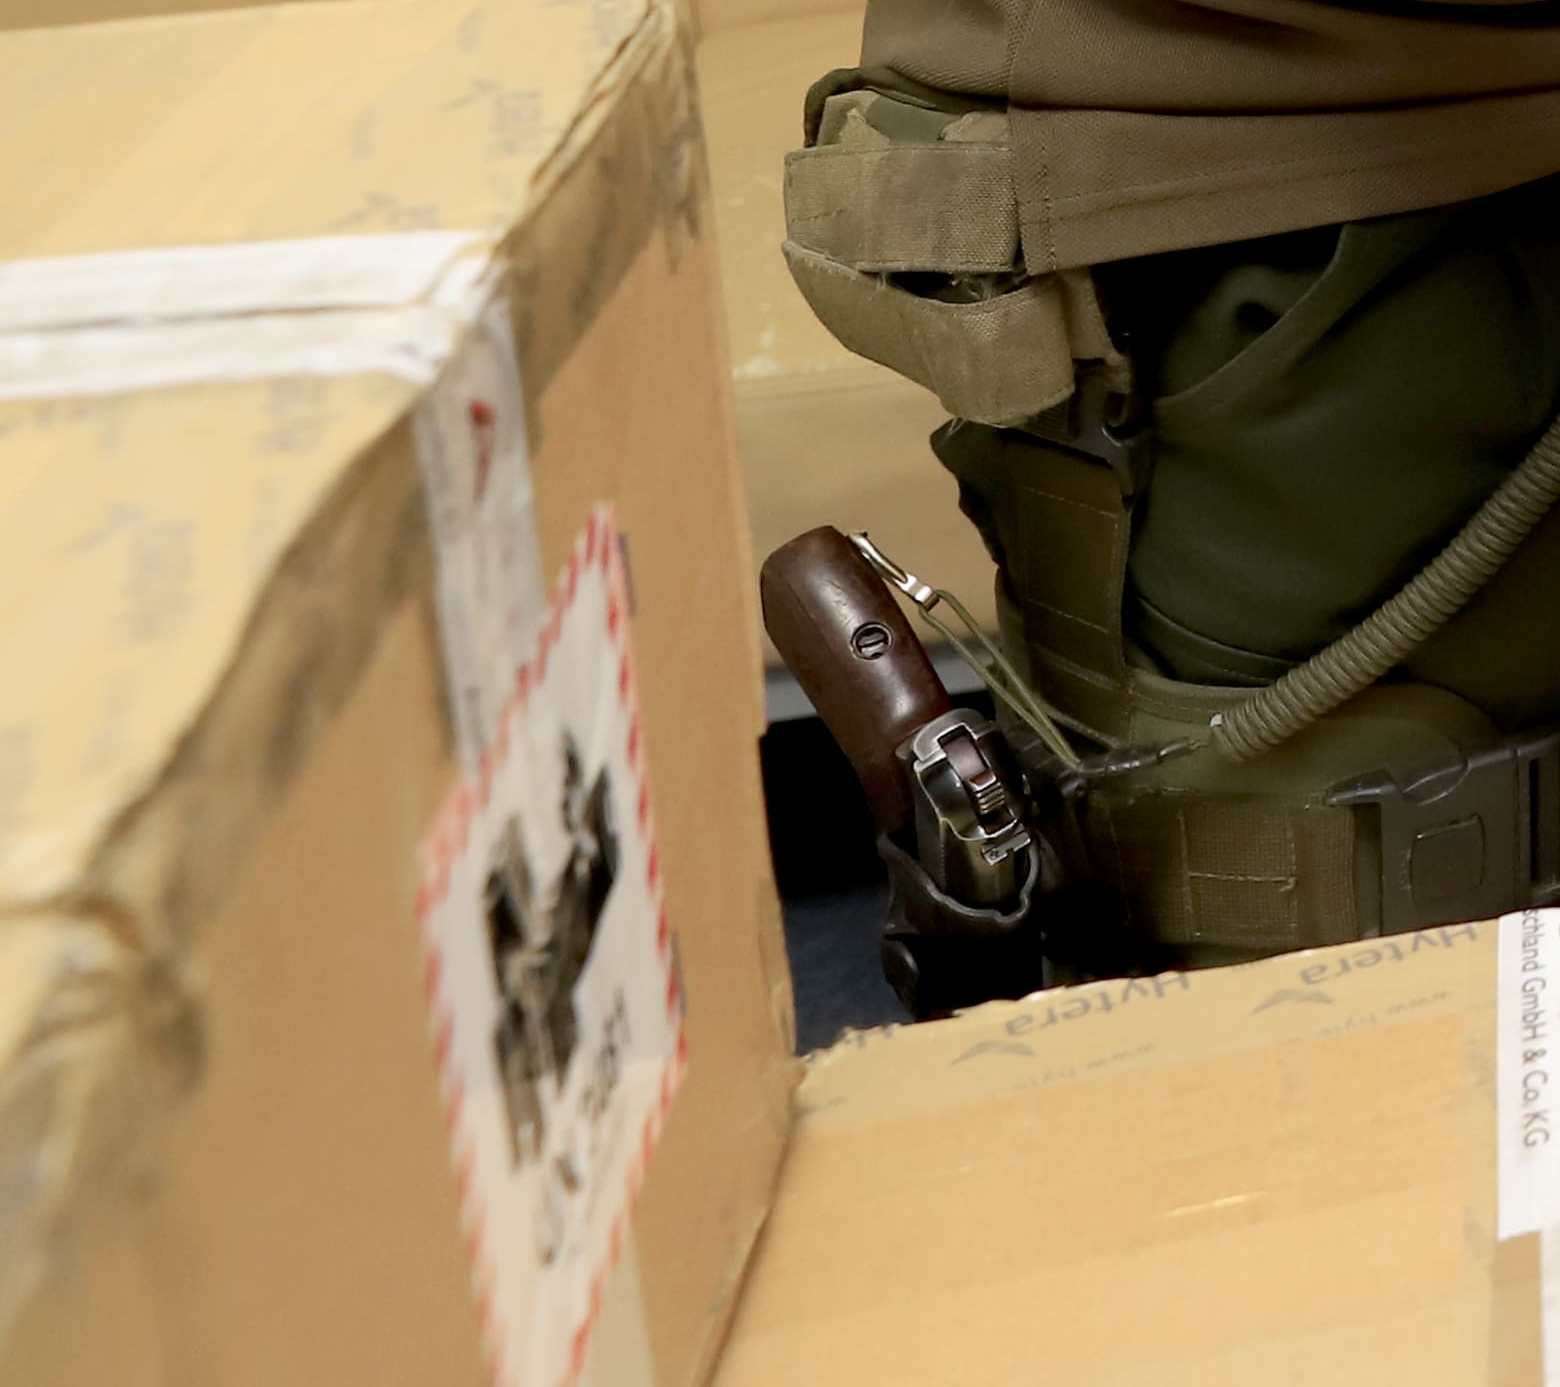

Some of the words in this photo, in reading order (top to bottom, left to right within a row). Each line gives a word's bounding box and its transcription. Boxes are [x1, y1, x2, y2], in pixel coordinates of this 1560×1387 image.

[1298, 920, 1479, 989] Hytera
[1520, 909, 1541, 973] schland
[1002, 968, 1193, 1039] Hytera
[1521, 976, 1547, 1042] GmbH
[1523, 1109, 1549, 1148] KG
